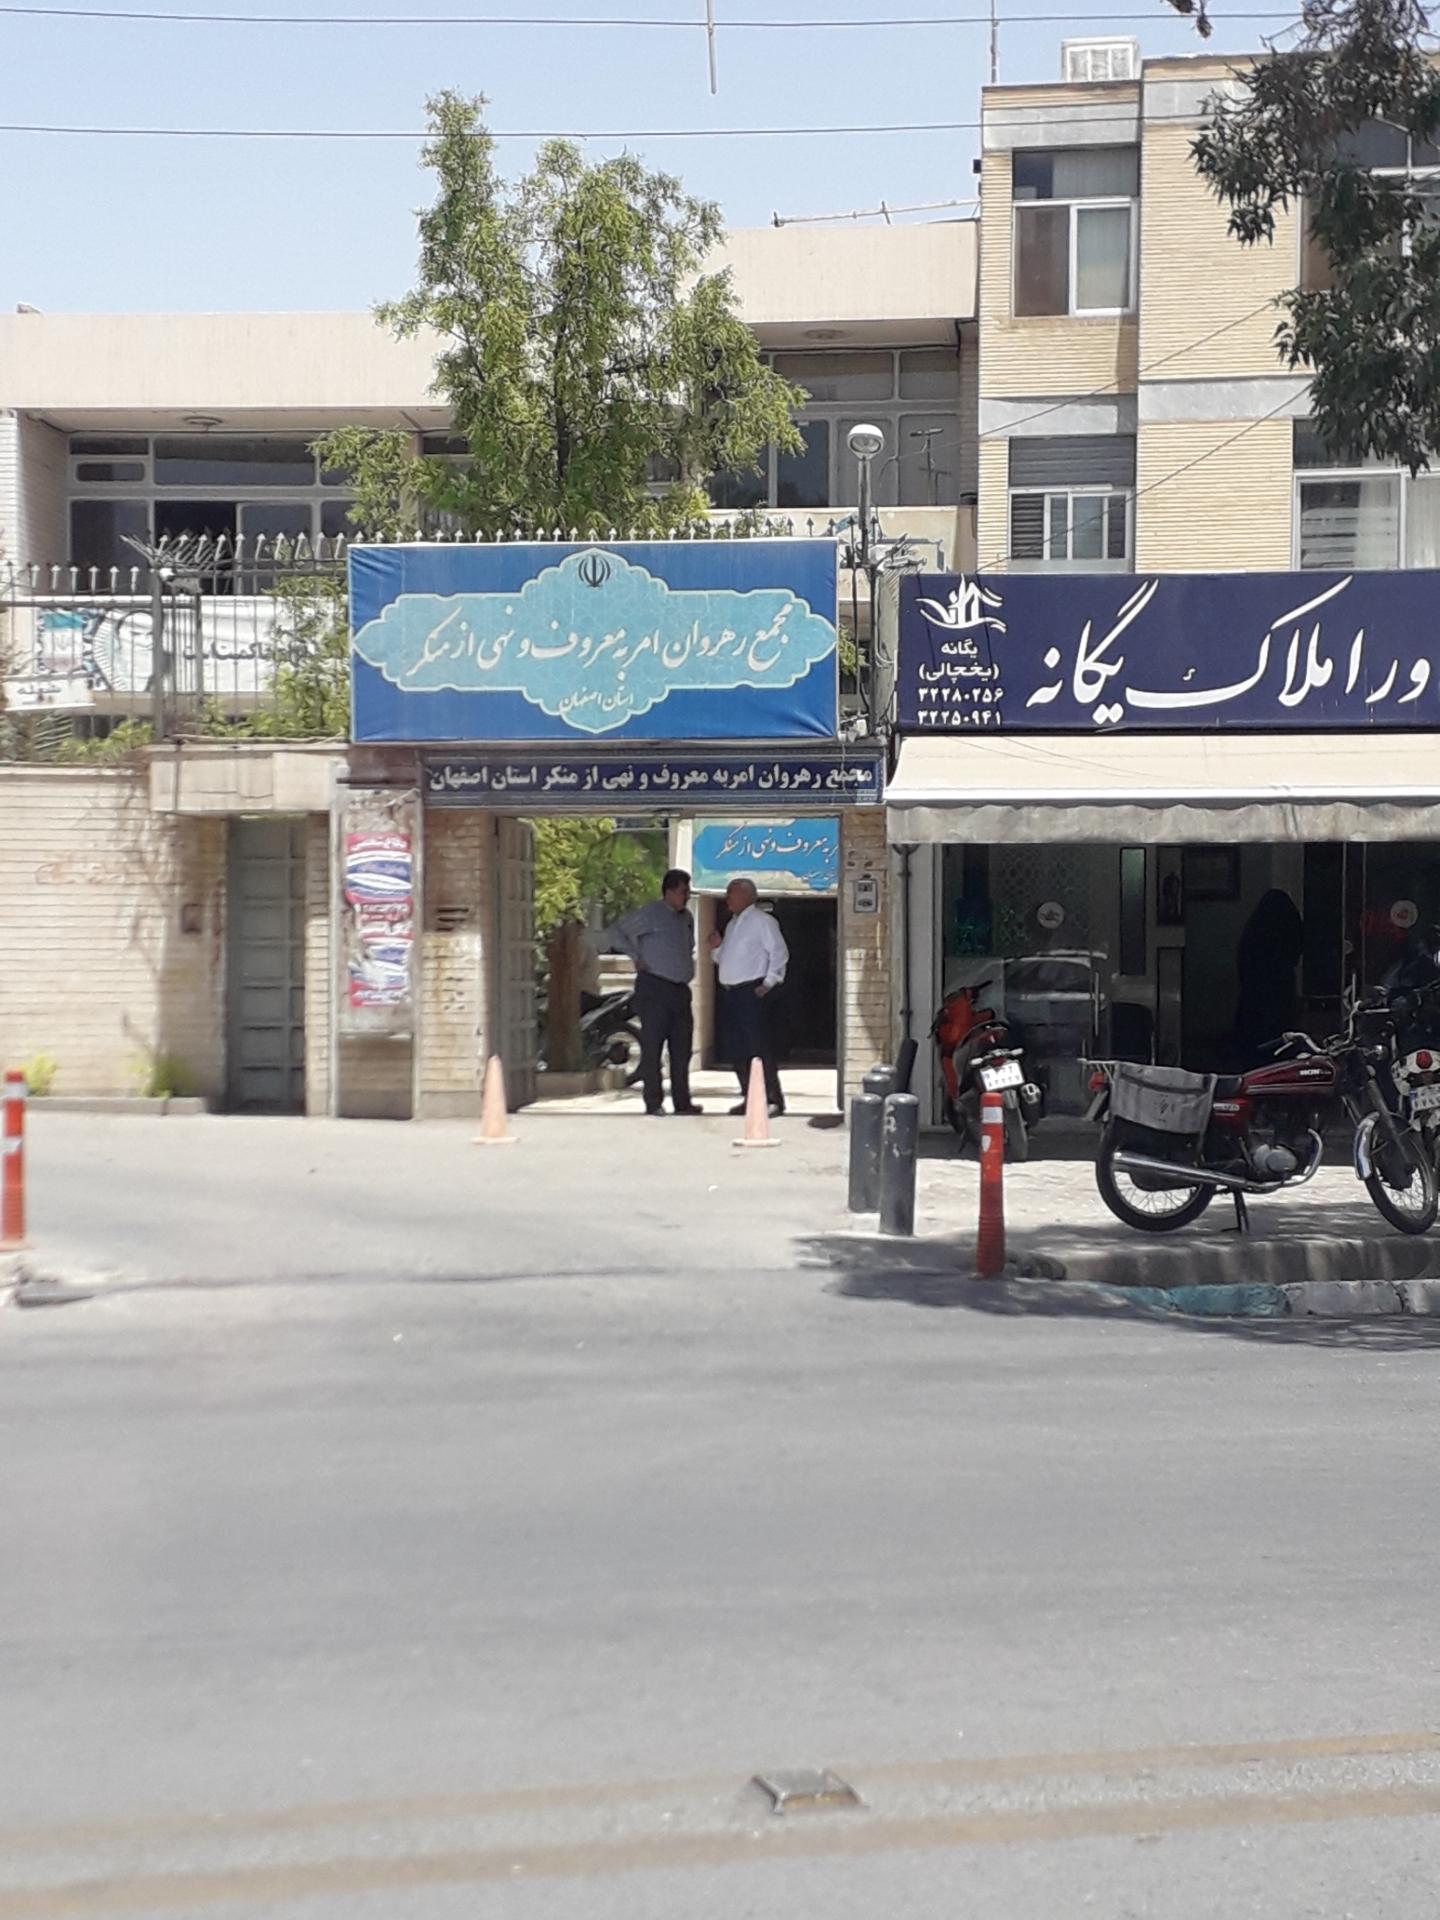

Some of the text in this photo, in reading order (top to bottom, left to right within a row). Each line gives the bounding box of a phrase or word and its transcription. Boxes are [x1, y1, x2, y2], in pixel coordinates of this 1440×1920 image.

[405, 603, 793, 681] مجمع رهروان امر به معروف و نهی از منکر
[941, 637, 978, 659] یگانه
[1025, 577, 1159, 725] یگانه
[1125, 575, 1364, 709] املاک
[918, 661, 1000, 684] (یخچالی)
[559, 685, 634, 713] استان اصفهان
[917, 687, 1004, 703] ۳۲۲۸۰۲۵۶
[917, 710, 1001, 725] ۳۲۲۵۰۹۴۱
[430, 765, 488, 790] اصفهان
[491, 764, 538, 790] استان
[541, 765, 578, 790] منکر
[582, 764, 599, 790] از
[602, 764, 635, 790] نهی
[638, 769, 649, 790] و
[652, 763, 709, 790] معروف
[757, 763, 821, 789] رهروان
[825, 766, 873, 788] مجمع
